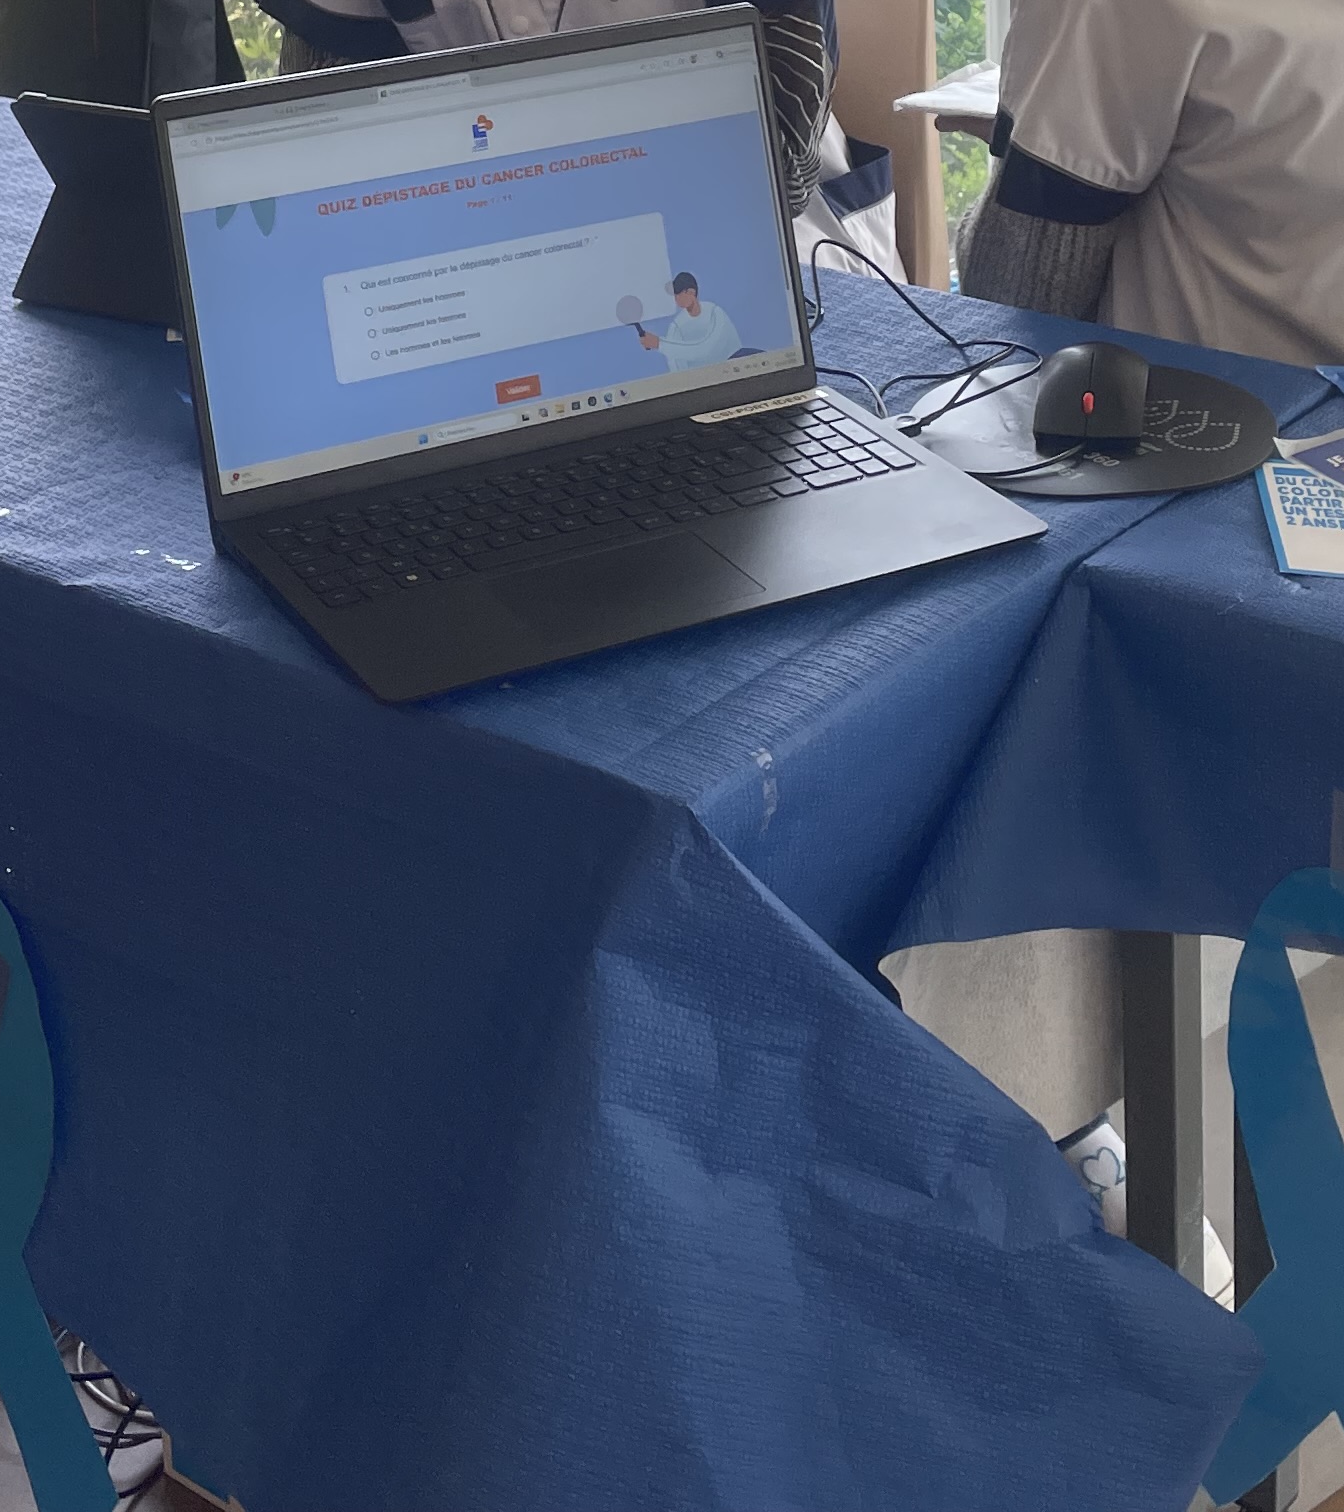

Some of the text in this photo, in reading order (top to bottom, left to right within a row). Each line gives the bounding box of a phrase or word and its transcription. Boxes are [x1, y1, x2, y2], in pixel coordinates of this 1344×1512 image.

[317, 145, 650, 217] QUIZ DÉPISTAGE DU CANCER COLORECTAL
[360, 279, 377, 291] Qui
[377, 277, 392, 287] est
[392, 267, 433, 285] concerné
[434, 265, 448, 278] par
[459, 254, 501, 272] dépistage
[502, 252, 513, 263] du
[514, 247, 543, 261] cancer
[544, 239, 584, 255] colorectal
[378, 297, 422, 313] Uniquement
[434, 289, 466, 302] hommes
[381, 319, 425, 336] Uniquement
[437, 311, 467, 324] femmes
[400, 341, 431, 355] hommes
[452, 331, 481, 343] femmes
[1276, 476, 1297, 486] DU
[1280, 496, 1343, 509] PARTIR
[1282, 506, 1308, 517] UN
[1286, 516, 1338, 529] 2 ANS
